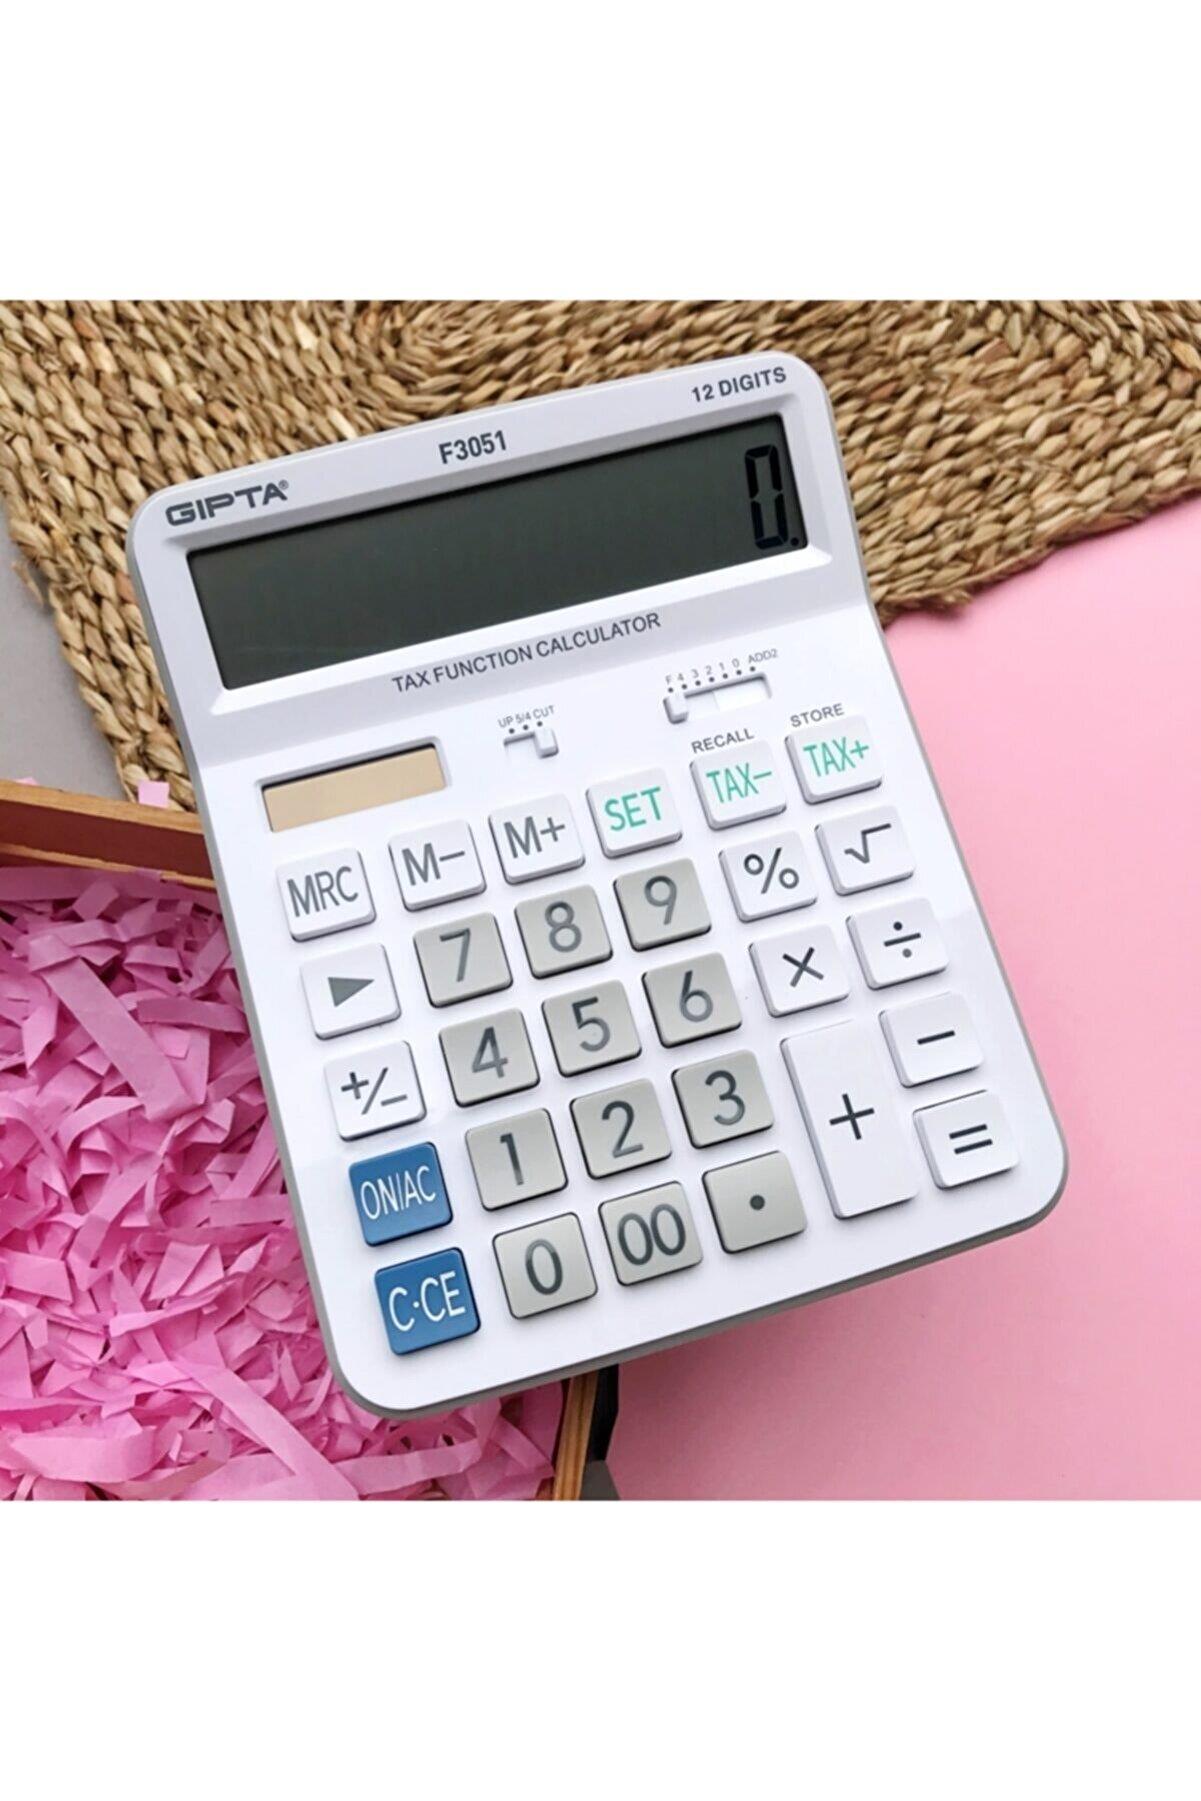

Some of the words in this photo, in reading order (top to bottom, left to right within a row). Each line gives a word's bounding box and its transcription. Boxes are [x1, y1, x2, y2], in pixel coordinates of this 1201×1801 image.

[692, 384, 714, 402] 12
[719, 366, 787, 397] DIGITS
[438, 430, 507, 464] F3051
[392, 672, 430, 692] TAX
[433, 646, 532, 683] FUNCTION
[536, 612, 661, 657] CALCULATOR
[706, 665, 714, 676] 2
[747, 648, 778, 664] ADD2
[497, 715, 514, 728] UP
[532, 704, 554, 719] CUT
[690, 728, 754, 754] RECALL
[790, 703, 844, 728] STORE
[803, 736, 869, 777] TAX+
[604, 787, 663, 832] SET
[503, 815, 565, 859] M+
[286, 866, 358, 918] MRC
[643, 875, 678, 925] 9
[543, 901, 583, 953] 8
[439, 928, 471, 982] 7
[678, 970, 713, 1022] 6
[572, 997, 611, 1052] 5
[471, 1026, 509, 1078] 4
[704, 1070, 746, 1125] 3
[601, 1100, 644, 1159] 2
[500, 1133, 524, 1186] 1
[617, 1203, 686, 1266] 00
[525, 1238, 563, 1296] 0
